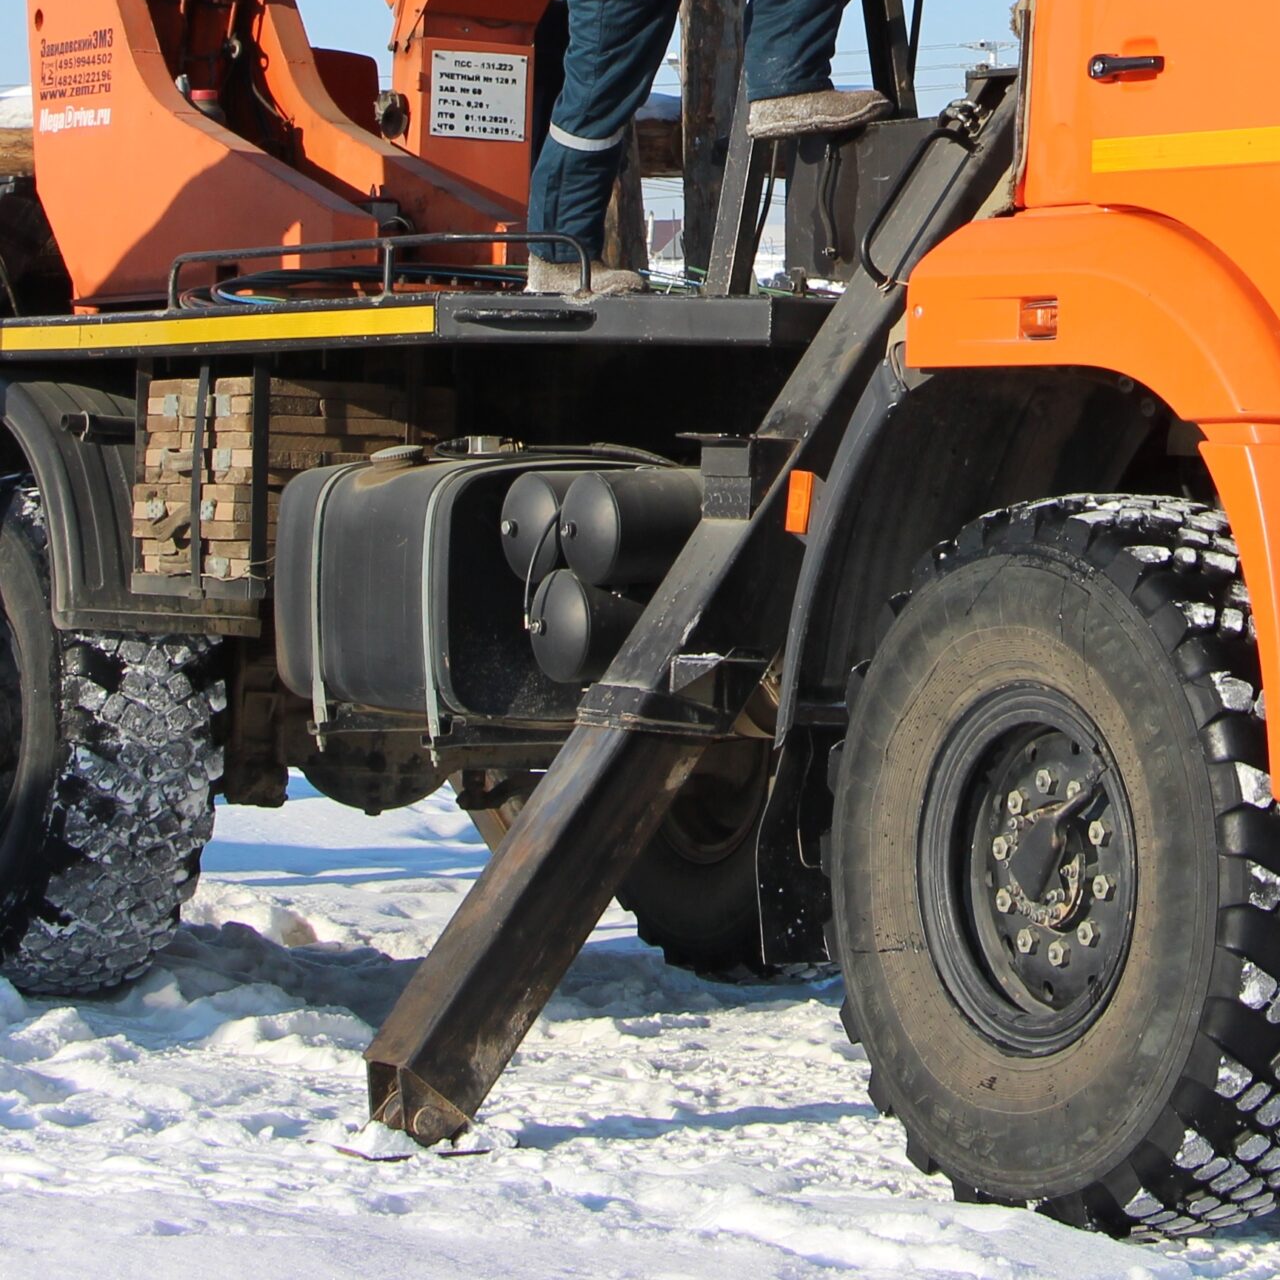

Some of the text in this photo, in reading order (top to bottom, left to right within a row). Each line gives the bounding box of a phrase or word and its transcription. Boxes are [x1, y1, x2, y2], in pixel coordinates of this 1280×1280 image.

[454, 60, 473, 69] ПСС
[39, 105, 112, 134] MegaDrive.ru
[437, 111, 455, 120] ПТО
[437, 123, 455, 131] ЧТО
